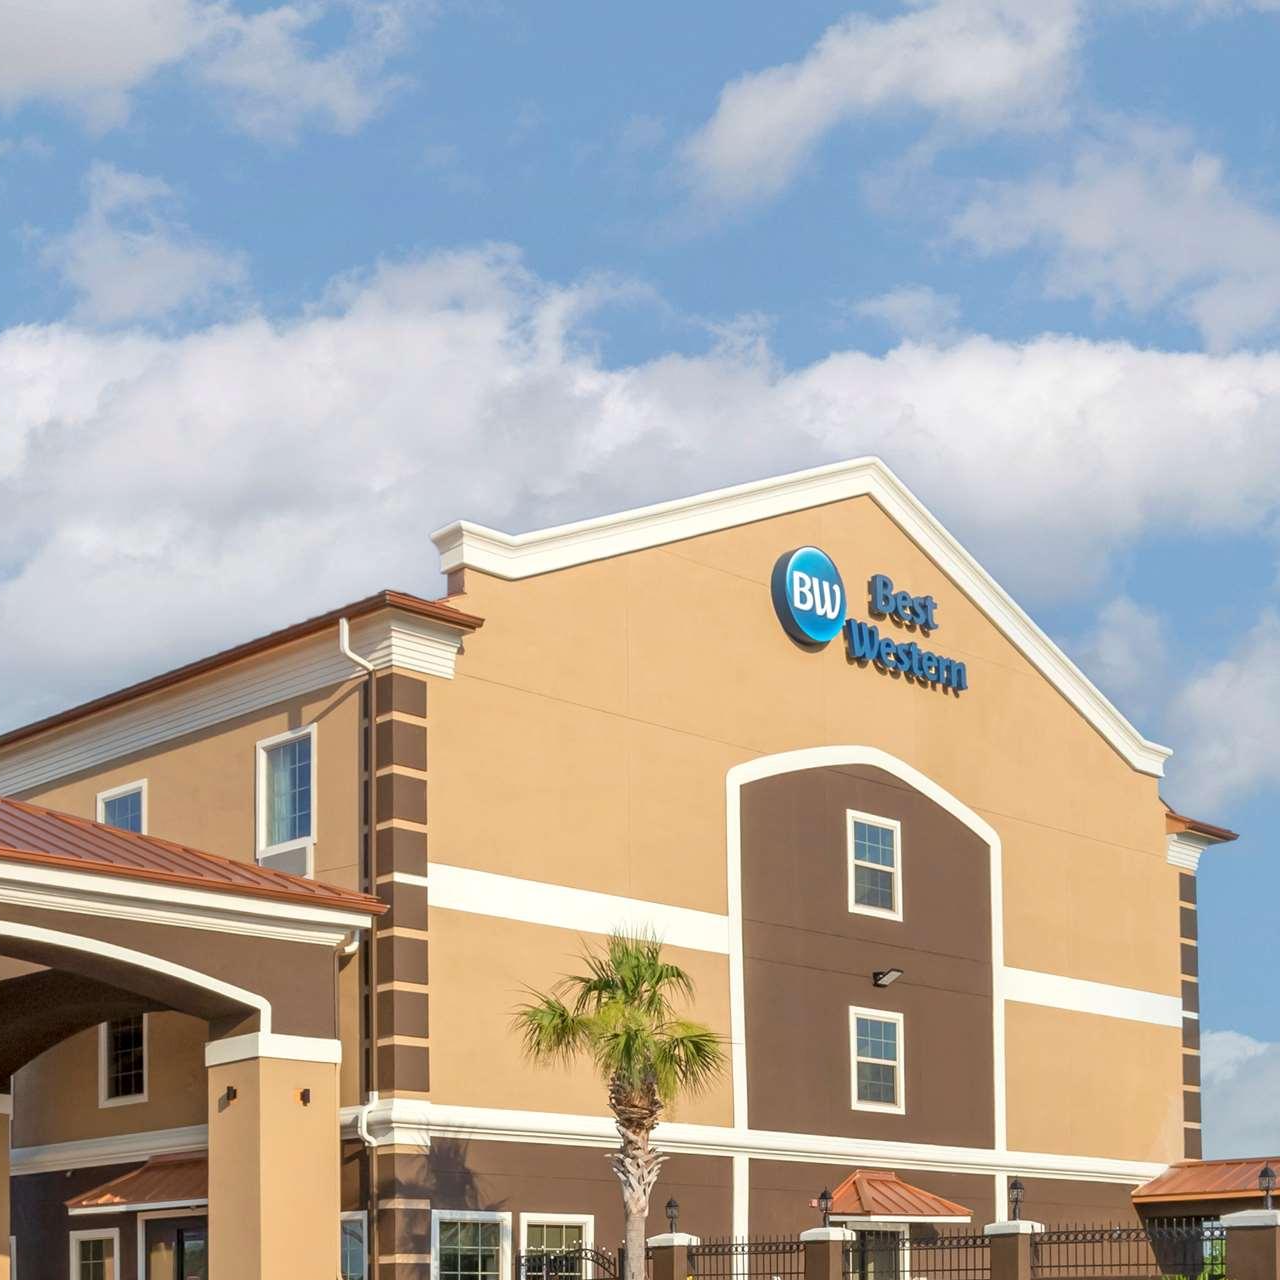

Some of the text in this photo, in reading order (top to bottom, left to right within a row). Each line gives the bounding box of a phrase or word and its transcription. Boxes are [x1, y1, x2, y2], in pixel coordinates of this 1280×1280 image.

[792, 570, 841, 620] BW
[869, 574, 939, 630] Best
[845, 618, 968, 691] Western
